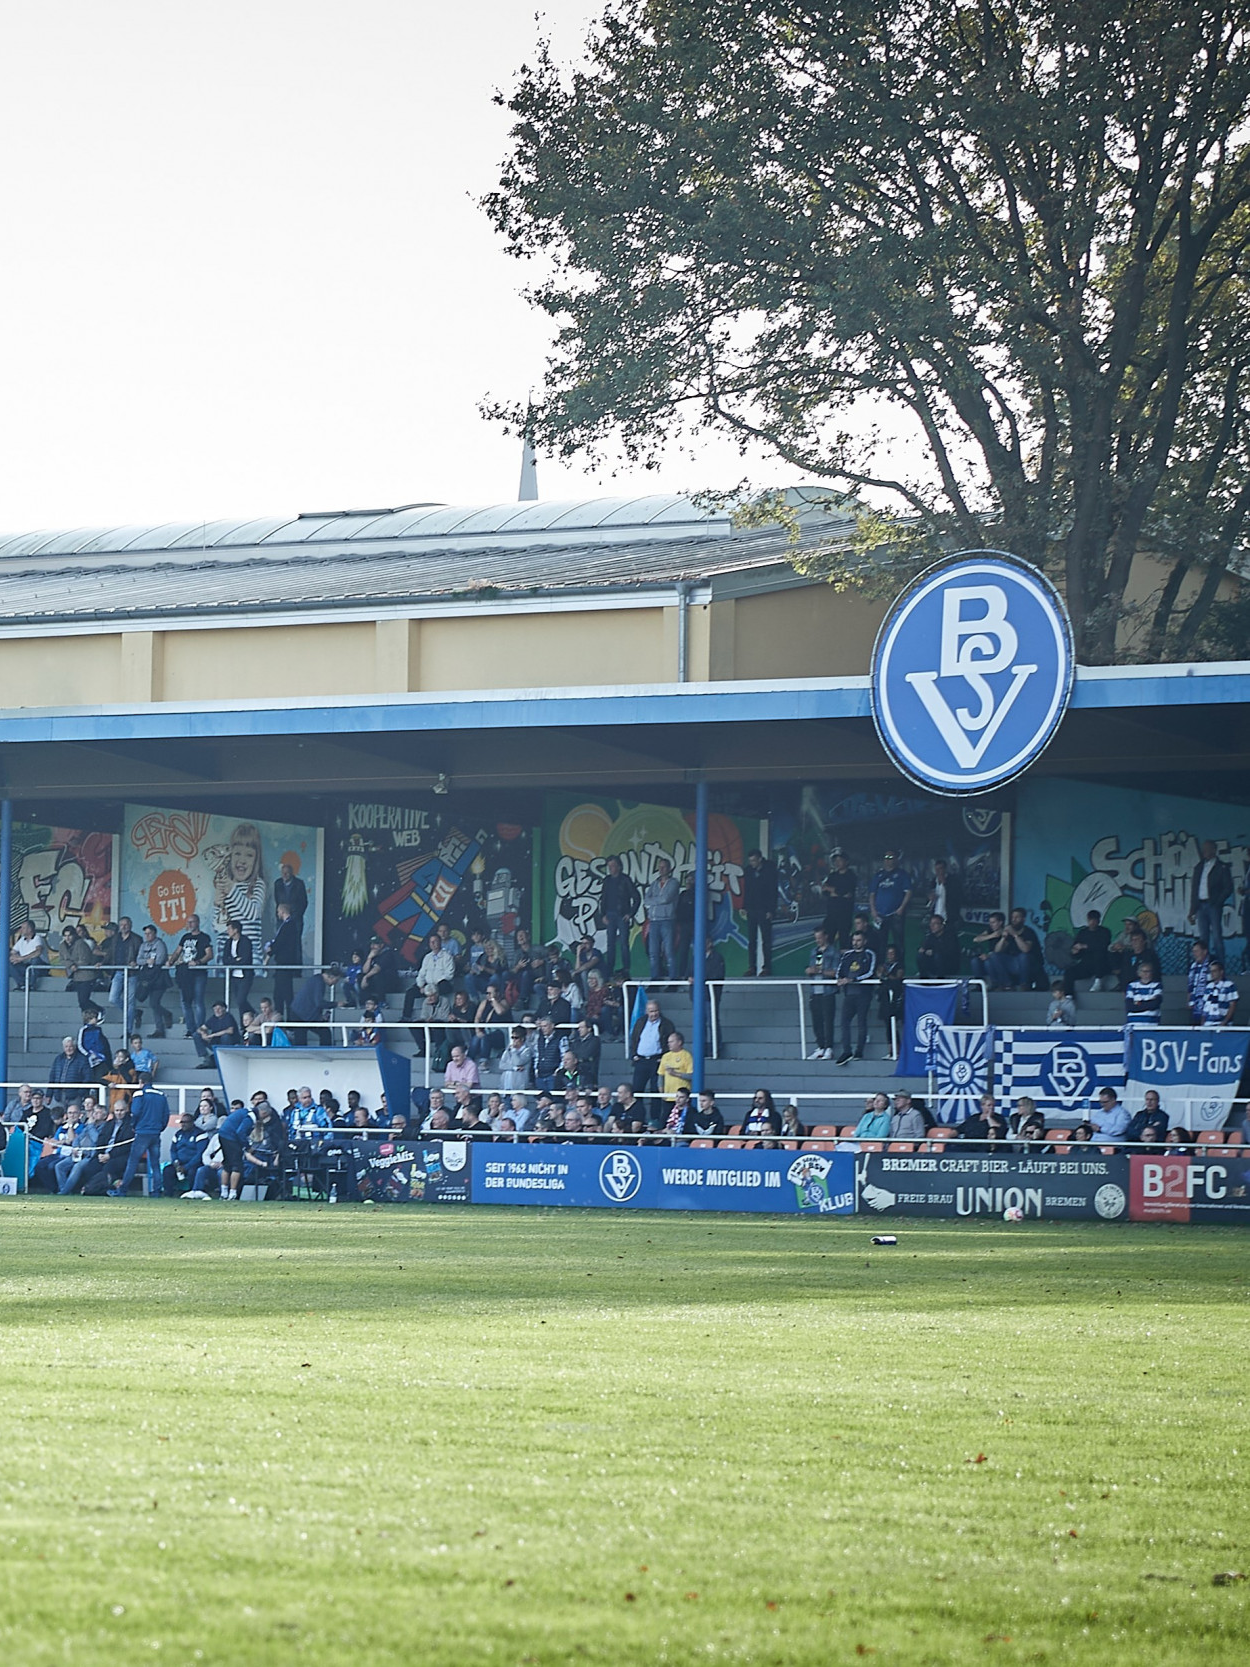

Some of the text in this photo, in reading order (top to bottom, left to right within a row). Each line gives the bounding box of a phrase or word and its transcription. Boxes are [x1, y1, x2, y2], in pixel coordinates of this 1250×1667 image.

[392, 829, 421, 847] WEB
[157, 882, 185, 897] Go for
[158, 897, 187, 922] IT!
[1141, 1038, 1243, 1073] BSV-Fans
[485, 1162, 568, 1175] SEIT 1962 NICHT IN
[882, 1158, 937, 1171] BREMER
[939, 1159, 979, 1172] CRAFT
[981, 1160, 1009, 1173] BIER
[1018, 1159, 1057, 1174] LÄUFT
[1059, 1162, 1079, 1174] BEI
[1081, 1163, 1109, 1174] UNS.
[485, 1177, 565, 1190] DER BUNDESLIGA
[662, 1168, 781, 1188] WERDE MITGLIED IM
[1143, 1163, 1227, 1200] B2FC
[818, 1192, 854, 1212] KLUB
[897, 1186, 1087, 1217] FREIE BRAU UNION BREMEN
